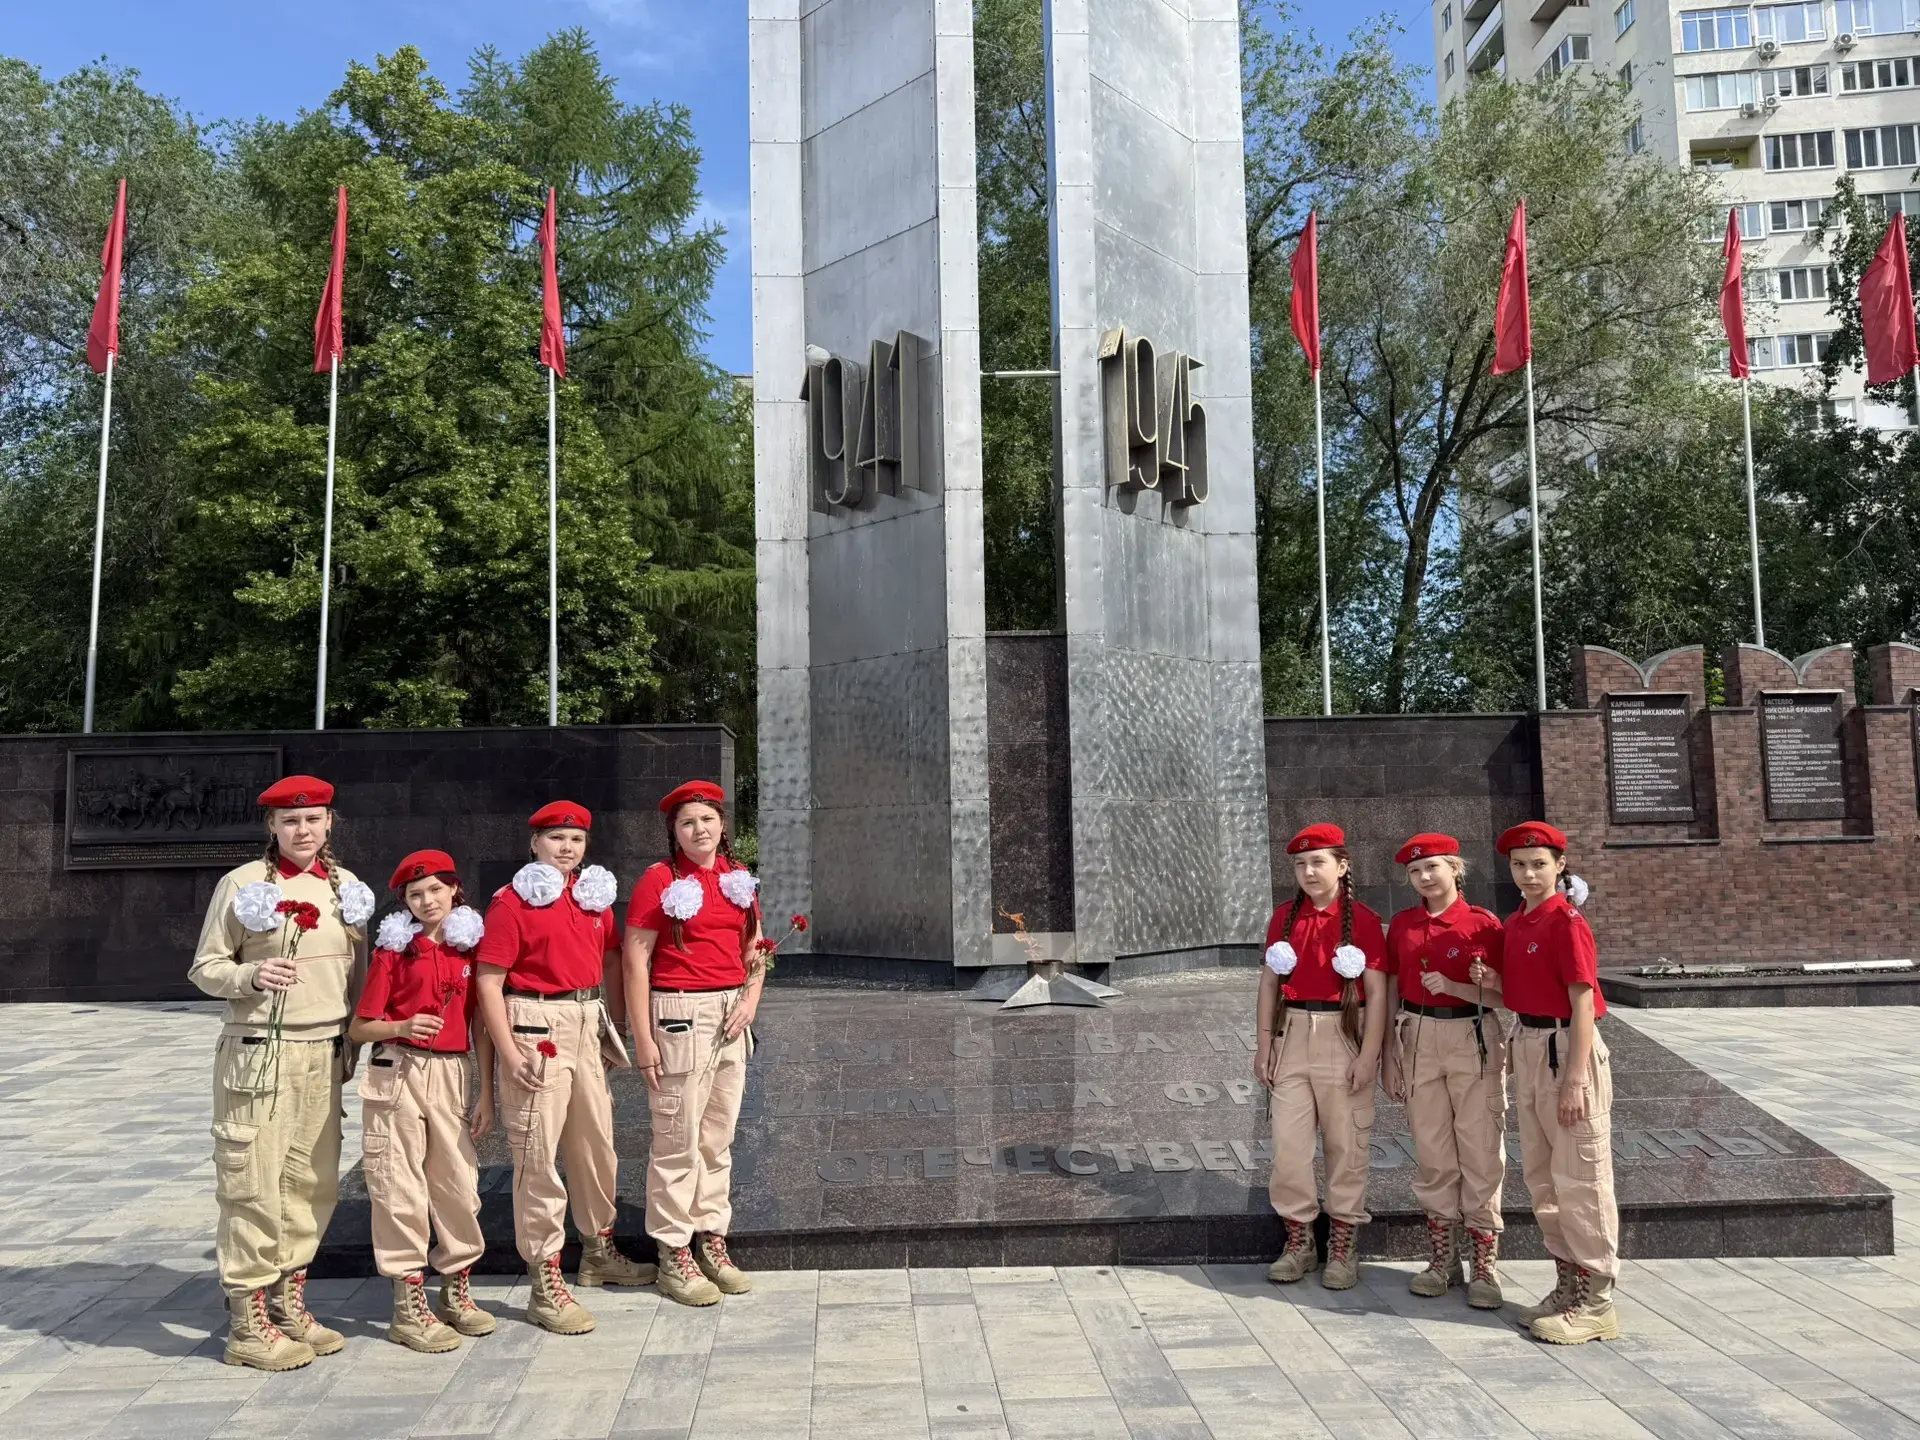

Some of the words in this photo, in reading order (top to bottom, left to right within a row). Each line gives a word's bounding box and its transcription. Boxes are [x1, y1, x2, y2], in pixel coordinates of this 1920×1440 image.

[800, 329, 920, 514] 1941
[1097, 326, 1211, 504] 1945
[1611, 708, 1640, 716] ДМИТРИЙ
[949, 1031, 1175, 1059] СЛАВА
[1012, 1081, 1120, 1109] НА
